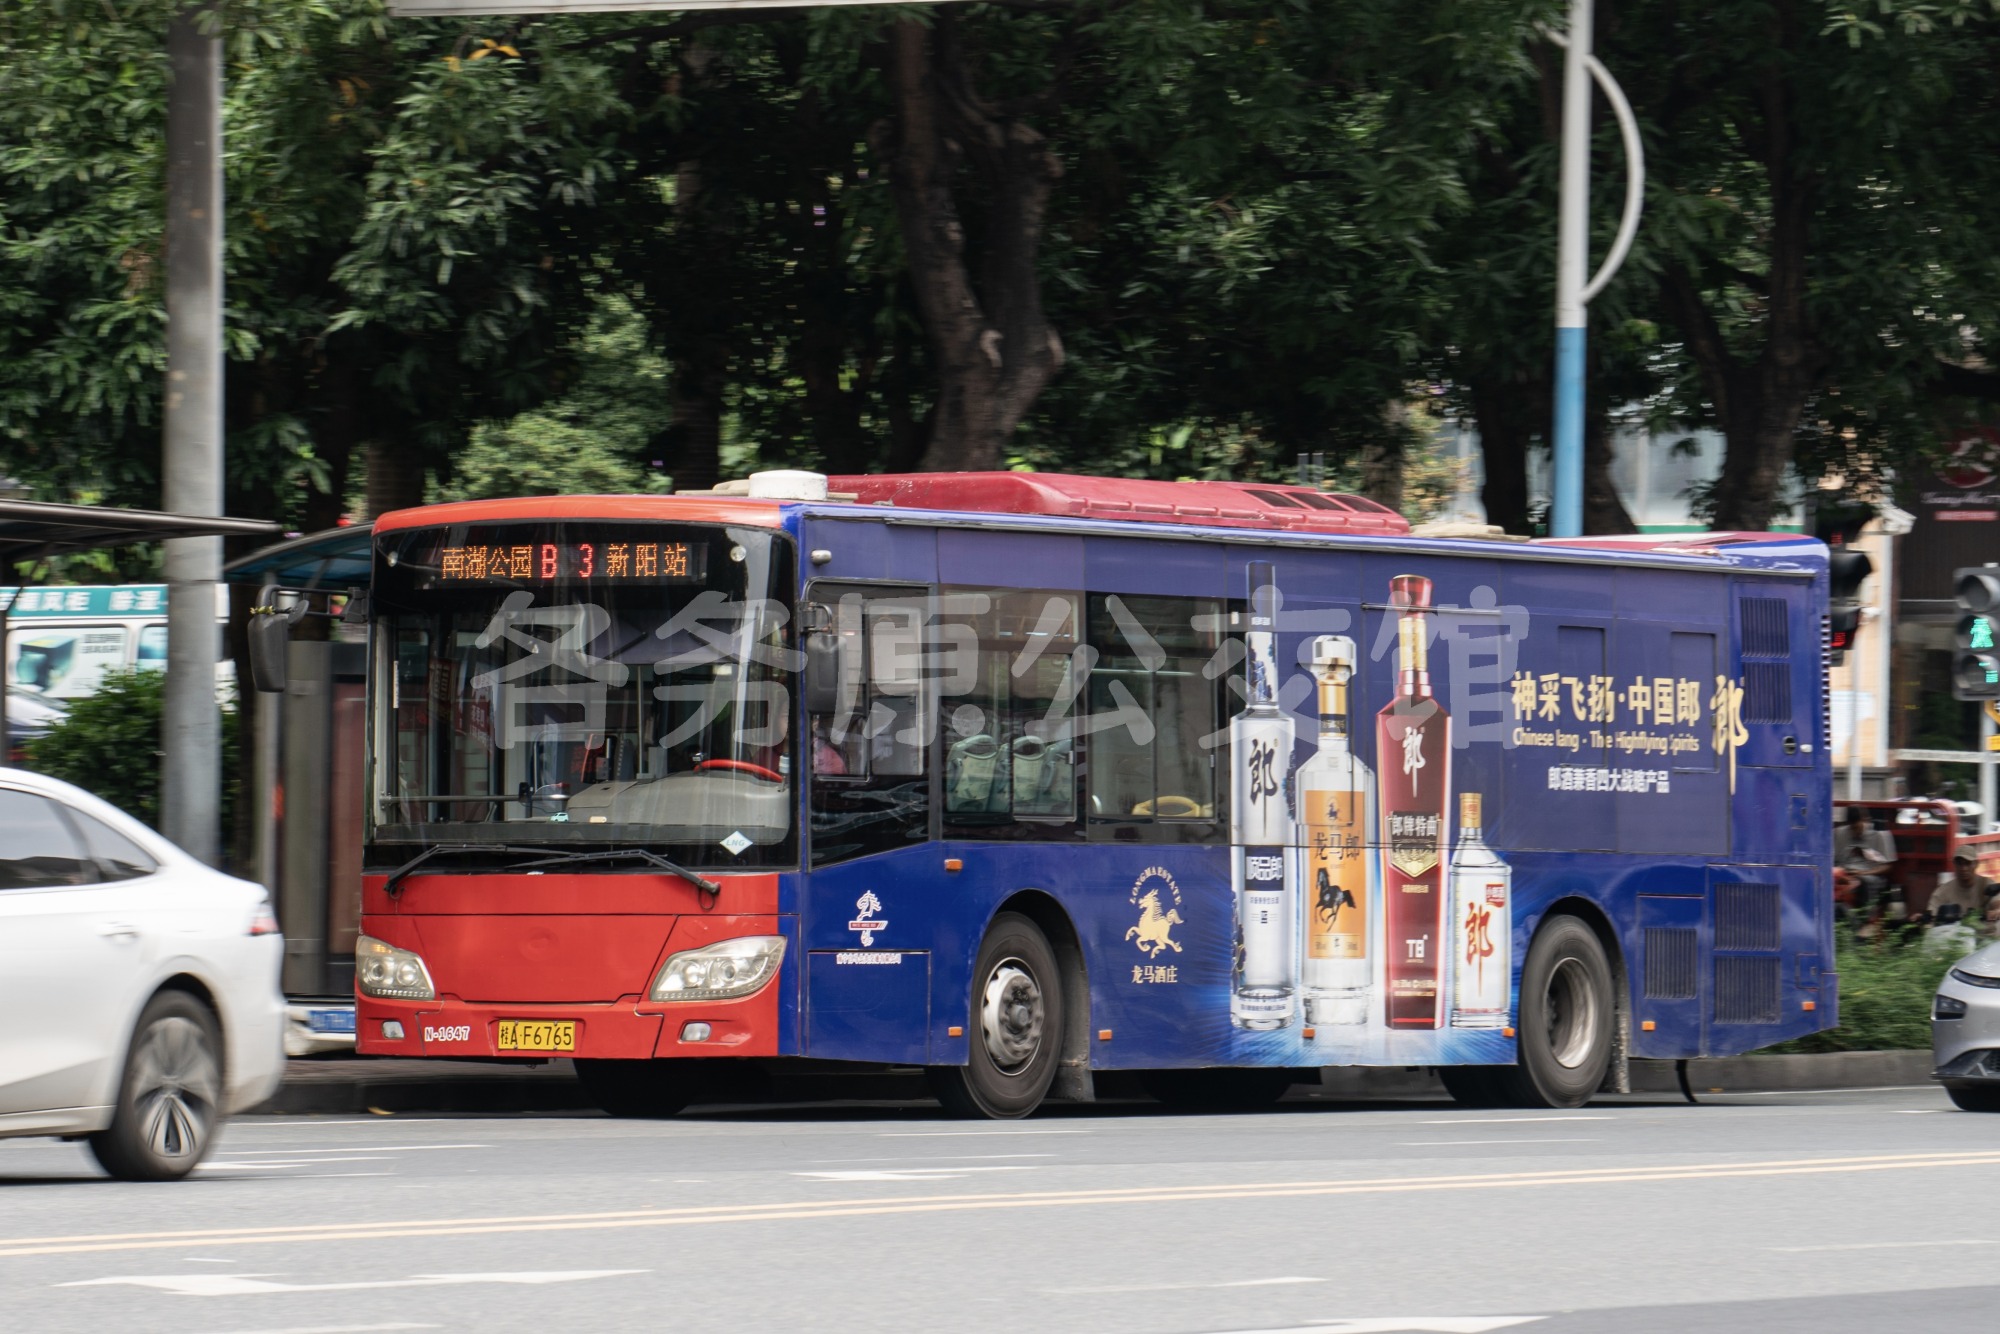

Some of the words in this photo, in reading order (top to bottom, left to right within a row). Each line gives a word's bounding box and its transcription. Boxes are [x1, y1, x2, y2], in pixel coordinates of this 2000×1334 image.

[441, 544, 533, 579] 南湖公园
[606, 543, 687, 577] 新阳站
[1512, 727, 1554, 746] Chinese
[1589, 730, 1613, 749] The
[1709, 674, 1749, 796] 郎
[1249, 739, 1278, 838] 郎
[1391, 815, 1438, 837] 郎牌特曲
[1313, 832, 1360, 861] 龙马郎
[1465, 901, 1494, 998] 郎
[1131, 965, 1179, 984] 龙马酒庄
[424, 1026, 470, 1042] N-1647
